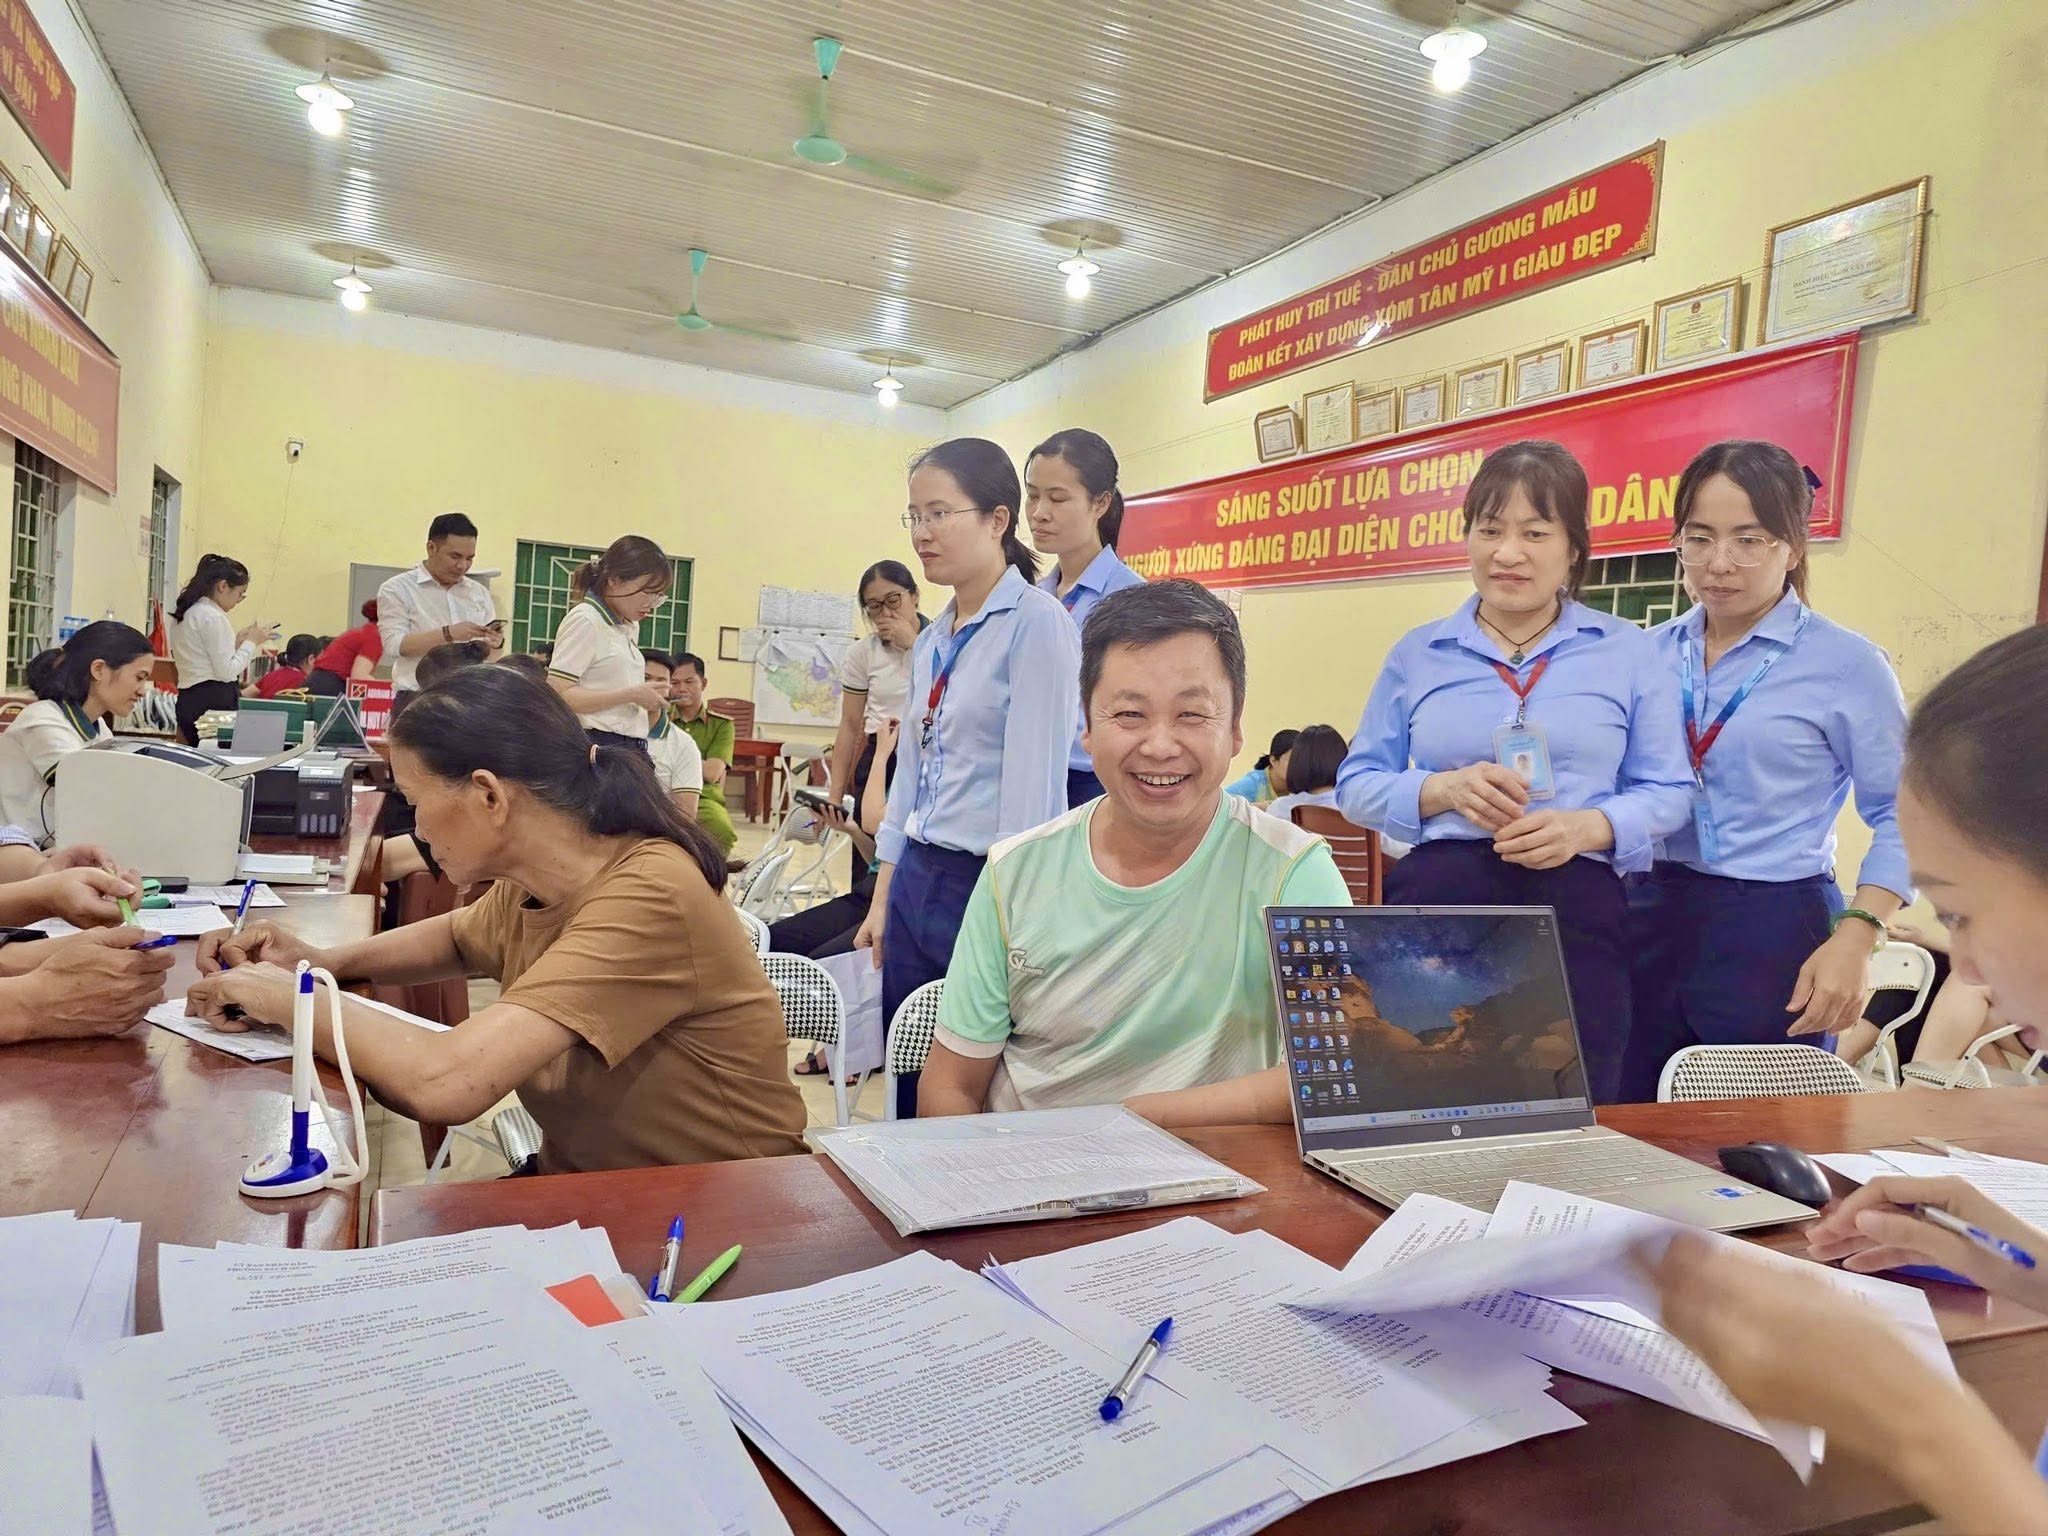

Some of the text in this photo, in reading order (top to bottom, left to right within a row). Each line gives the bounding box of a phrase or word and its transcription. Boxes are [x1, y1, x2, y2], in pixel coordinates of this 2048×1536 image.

[1228, 352, 1264, 382] ĐOÀN
[1266, 342, 1291, 368] KẾT
[1294, 330, 1324, 359] XÂY
[1327, 316, 1370, 345] DỰNG
[1375, 297, 1414, 327] XÓM
[1419, 282, 1457, 314] TÂN
[1462, 265, 1495, 300] MỸ
[1513, 241, 1567, 281] GIÀU
[1572, 223, 1623, 261] ĐẸP
[1239, 318, 1271, 347] PHÁT
[1275, 306, 1304, 333] HUY
[1307, 292, 1330, 320] TRÍ
[1334, 280, 1362, 306] TUỆ
[1378, 260, 1415, 293] DÂN
[1419, 238, 1458, 276] CHỦ
[1464, 212, 1536, 259] GƯƠNG
[1542, 186, 1597, 229] MẪU
[1173, 541, 1224, 574] XỨNG
[1228, 532, 1286, 569] ĐÁNG
[1291, 526, 1331, 566] ĐẠI
[1337, 514, 1400, 560] DIỆN
[1590, 473, 1681, 528] DÂN
[1216, 449, 1484, 528] SÁNG SUỐT LỰA CHỌN
